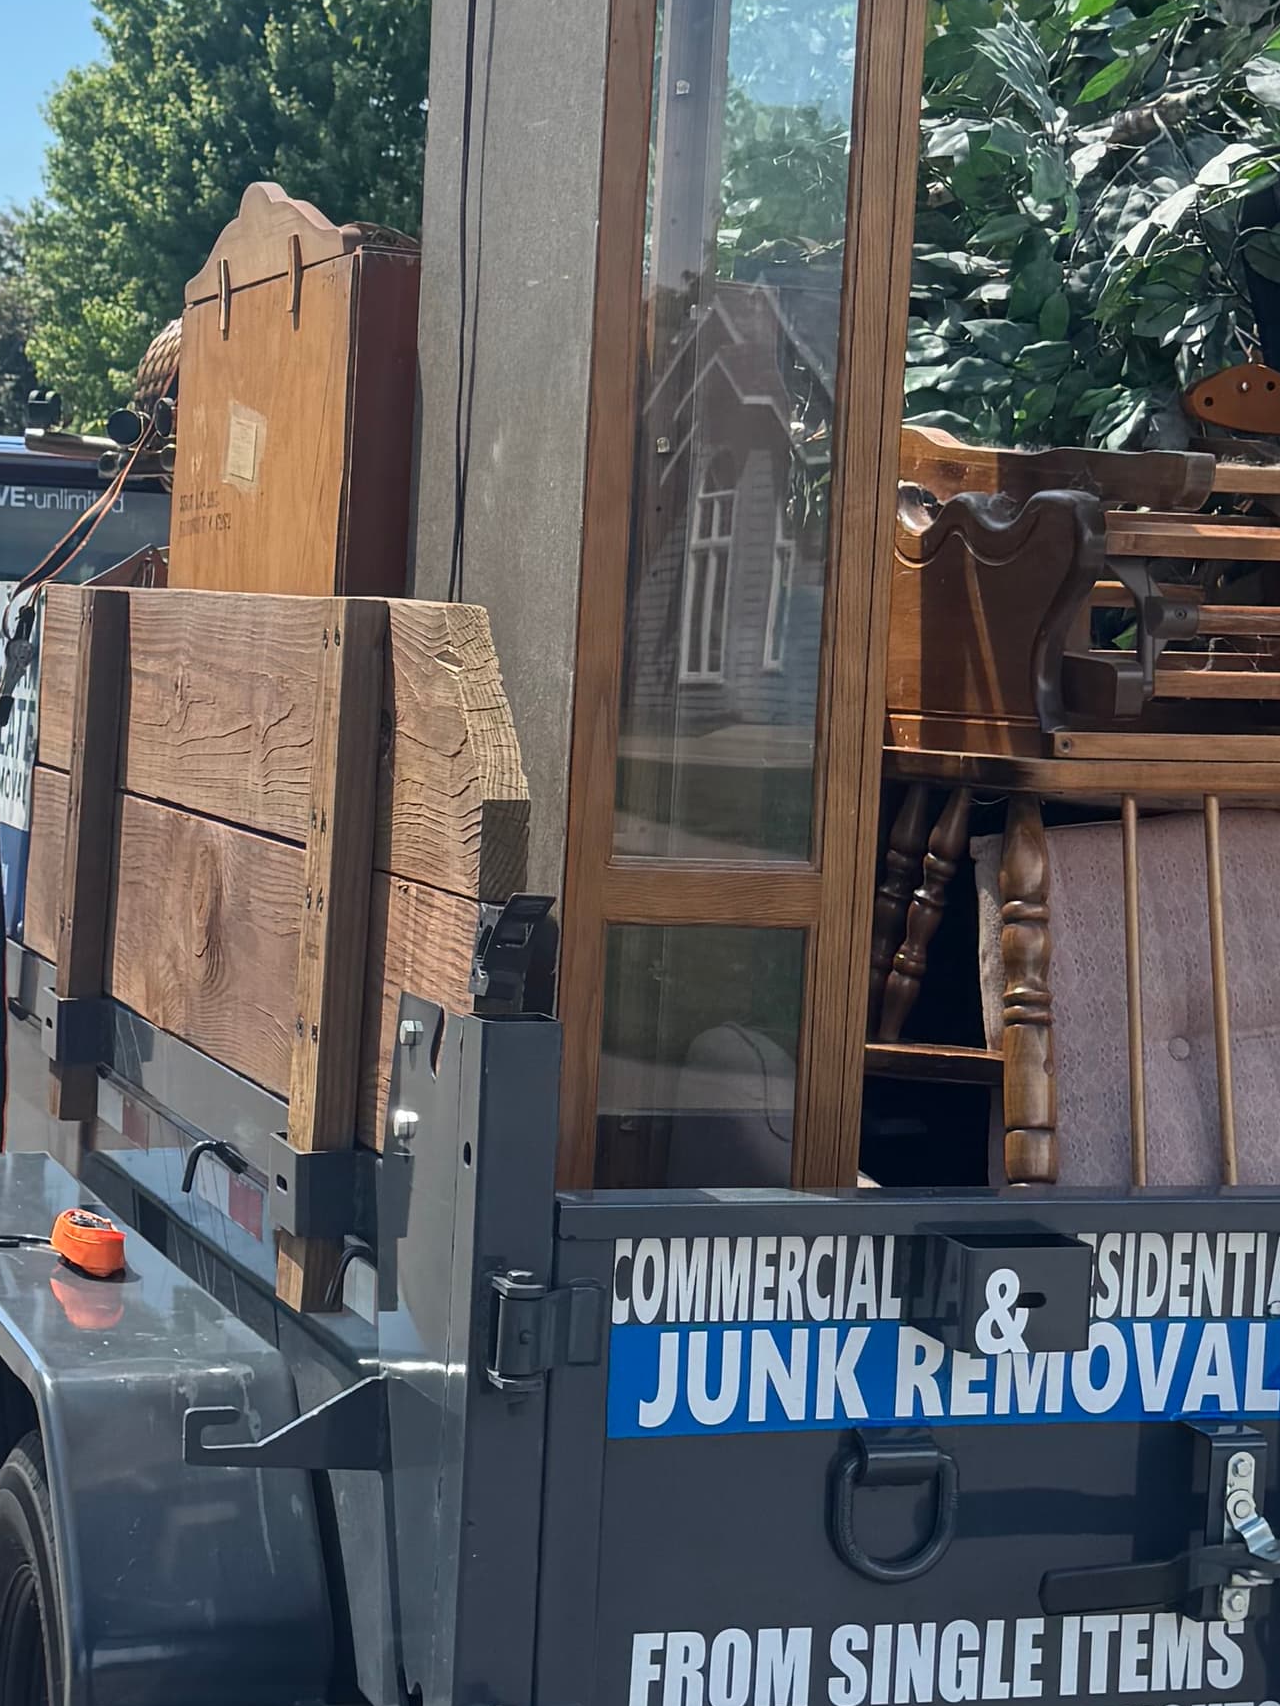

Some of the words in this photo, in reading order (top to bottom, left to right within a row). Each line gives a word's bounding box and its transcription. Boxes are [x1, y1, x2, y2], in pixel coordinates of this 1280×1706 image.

[612, 1234, 901, 1324] COMMERCIAL
[975, 1268, 1029, 1355] &
[638, 1326, 872, 1428] JUNK
[895, 1321, 1280, 1419] REMOVAL
[1060, 1613, 1244, 1694] ITEMS
